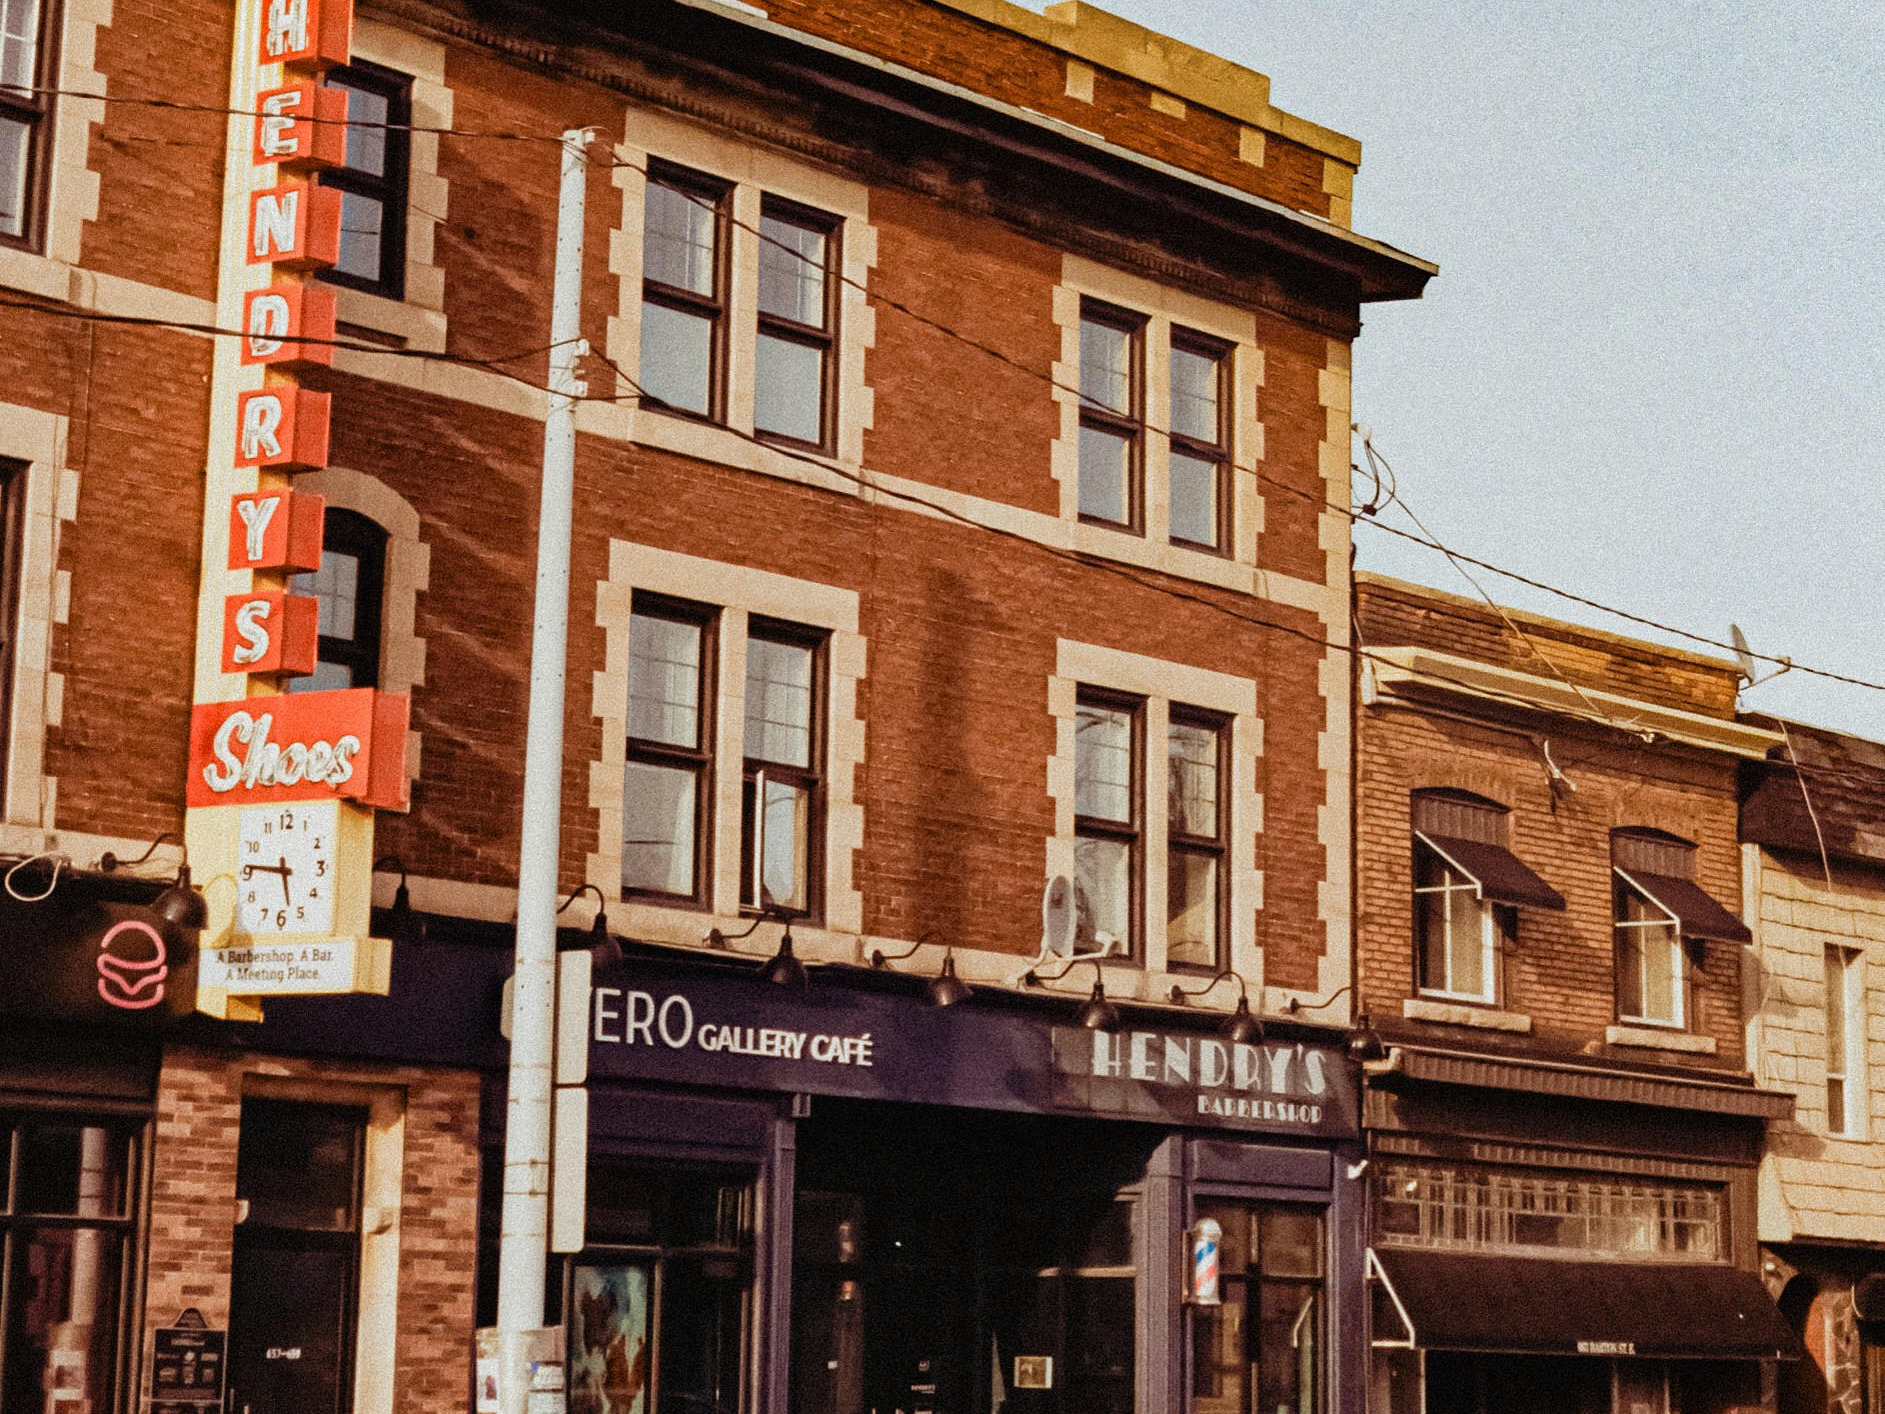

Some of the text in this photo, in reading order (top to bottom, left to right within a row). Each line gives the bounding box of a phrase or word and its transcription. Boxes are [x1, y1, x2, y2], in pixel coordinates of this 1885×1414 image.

[203, 710, 361, 792] Shoes
[264, 822, 272, 834] 11
[279, 814, 293, 830] 12
[248, 841, 260, 853] 10
[313, 838, 320, 849] 2
[242, 865, 253, 881] 9
[316, 860, 325, 877] 3
[247, 891, 256, 903] 8
[309, 888, 318, 899] 4
[261, 908, 269, 921] 7
[276, 910, 286, 927] 6
[296, 907, 305, 919] 5
[216, 952, 224, 963] A
[300, 949, 309, 961] A
[226, 968, 234, 980] A
[237, 966, 284, 982] Meeting
[588, 986, 873, 1066] ERO GALLERY CAFÉ
[1092, 1029, 1327, 1095] HENDRY'S
[1198, 1094, 1323, 1124] BARBERSHOP
